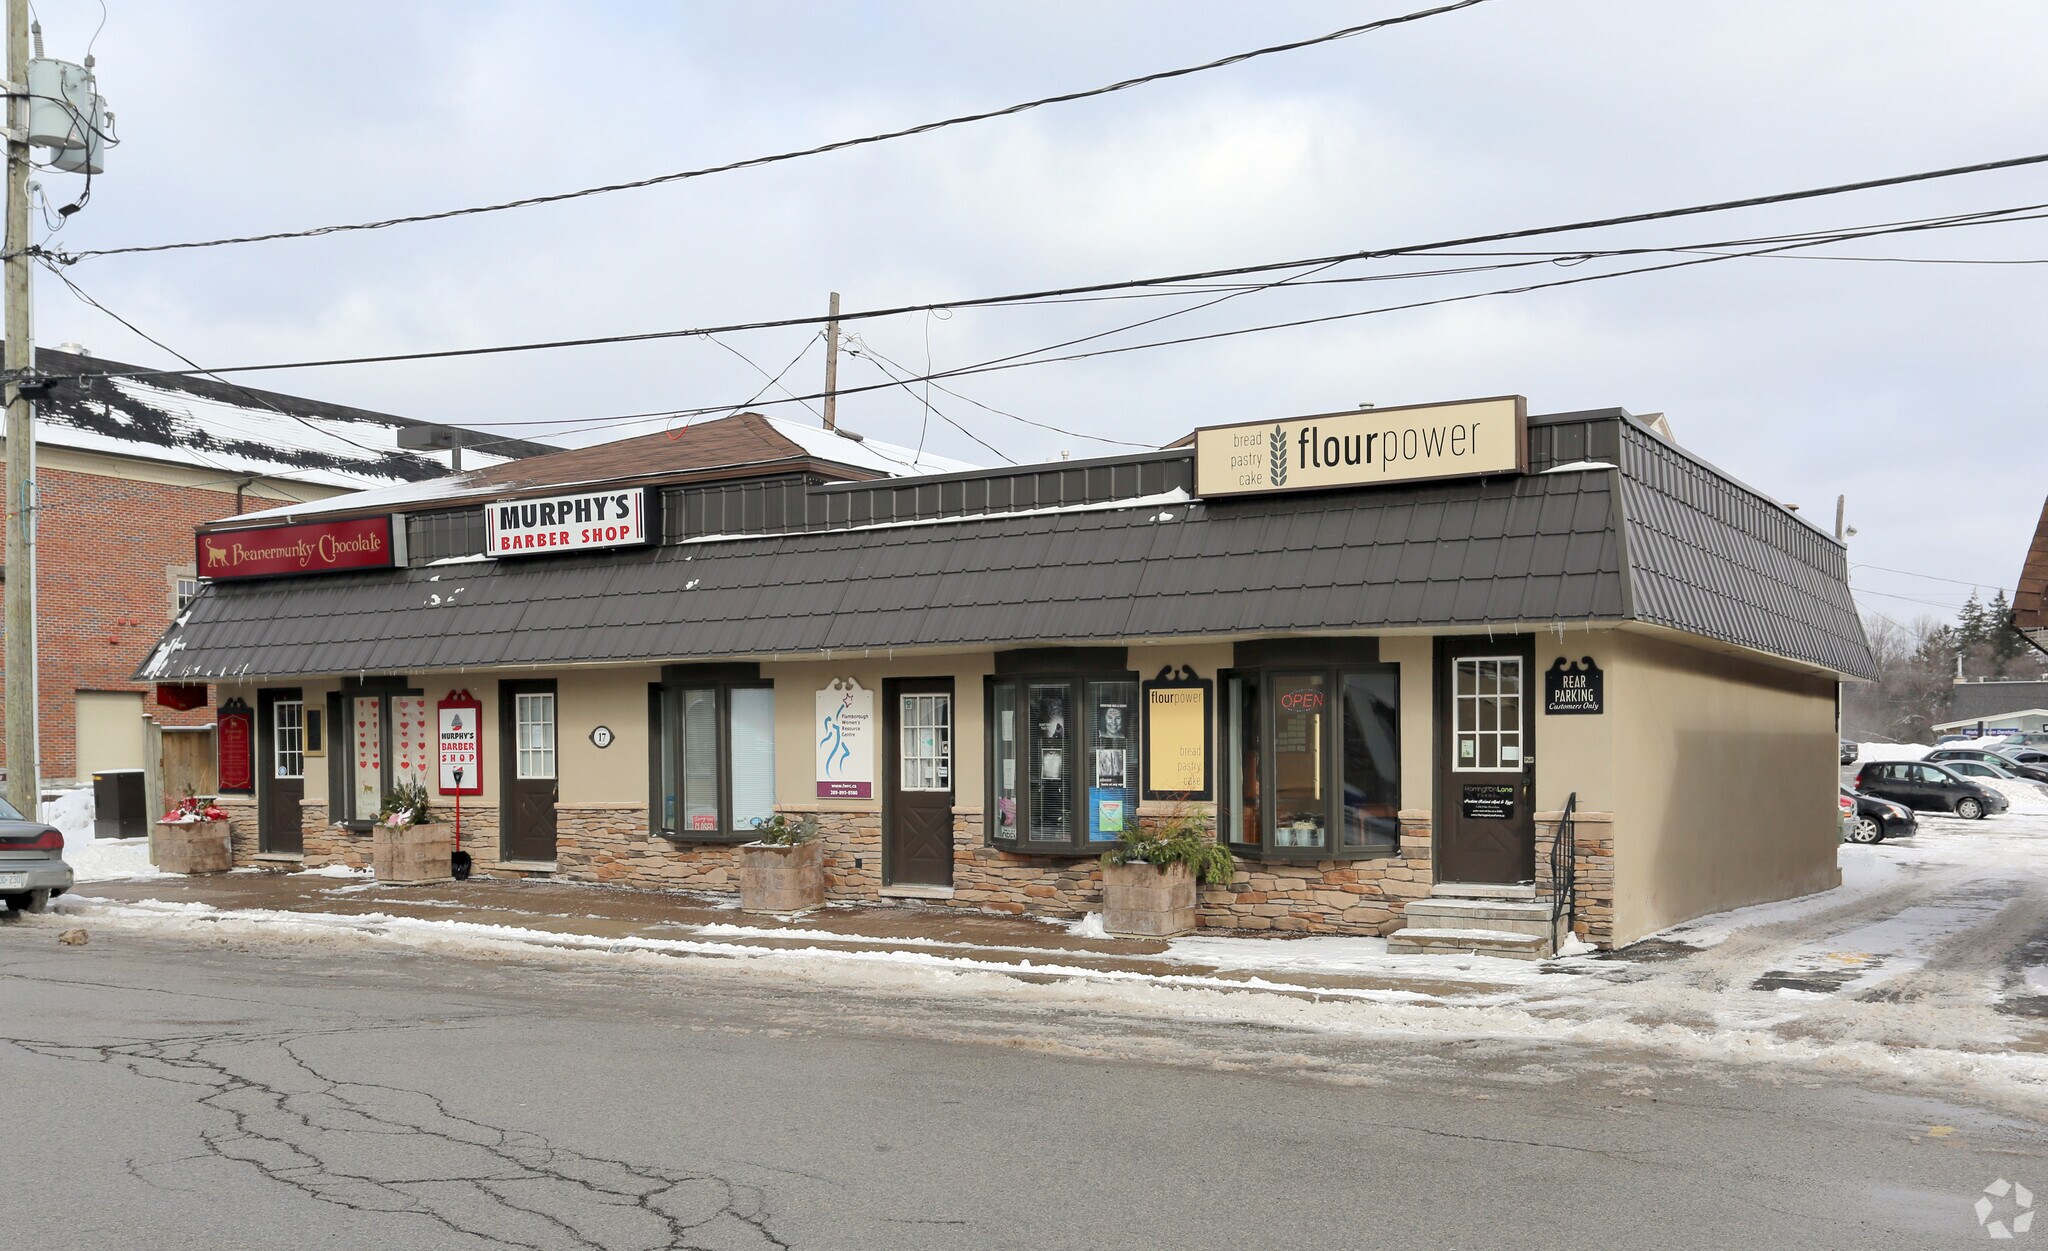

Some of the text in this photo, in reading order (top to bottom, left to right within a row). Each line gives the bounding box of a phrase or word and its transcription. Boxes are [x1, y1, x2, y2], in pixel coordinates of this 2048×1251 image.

[1233, 430, 1263, 448] bread
[1298, 421, 1481, 472] flourpower
[1230, 450, 1263, 474] pastry
[1238, 471, 1263, 487] cake
[500, 494, 631, 531] MURPHY'S
[501, 525, 630, 551] BARBER SHOP
[232, 532, 381, 567] Beanermunky Chocolate
[1563, 675, 1586, 688] REAR
[1151, 691, 1202, 705] flourpower
[1281, 693, 1324, 708] OPEN
[1555, 689, 1594, 702] PARKING
[1549, 701, 1599, 710] Customers Only
[442, 732, 474, 740] MURPHY'S
[599, 733, 606, 742] 17
[442, 742, 474, 751] BARBER
[1180, 746, 1201, 757] bread
[442, 754, 474, 762] SHOP
[1178, 762, 1201, 774] pastry
